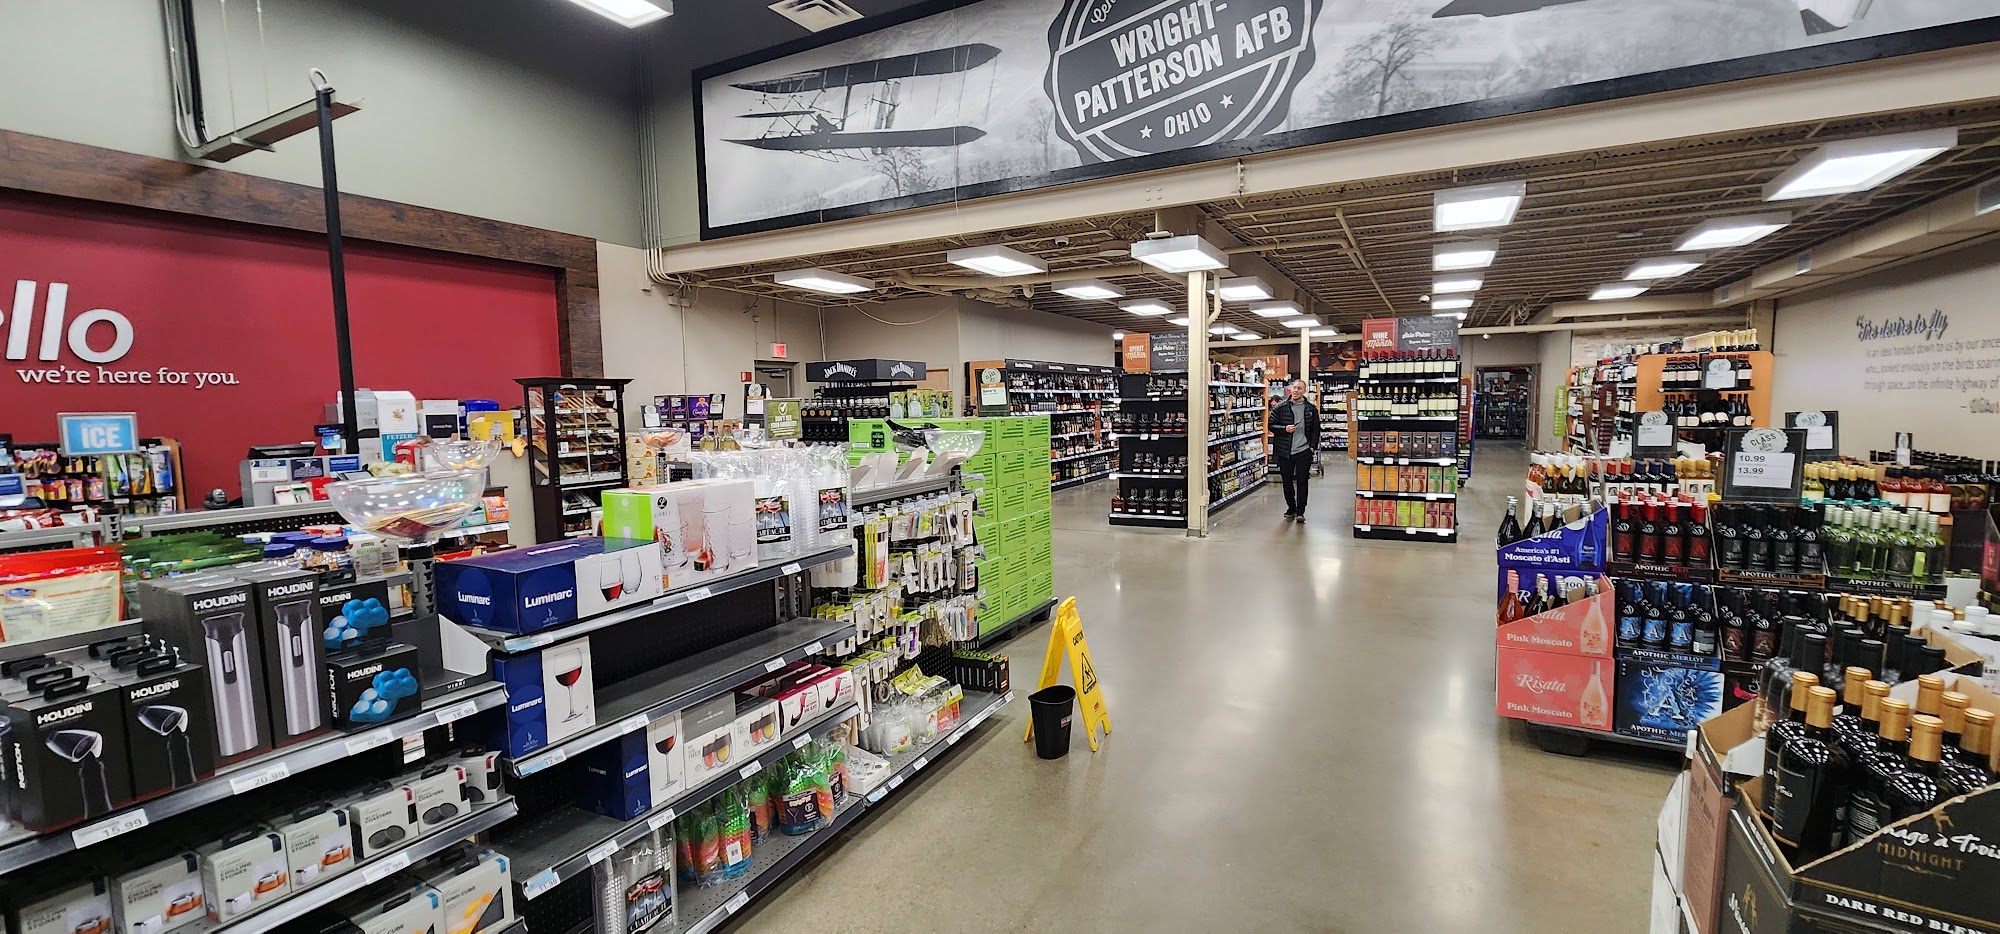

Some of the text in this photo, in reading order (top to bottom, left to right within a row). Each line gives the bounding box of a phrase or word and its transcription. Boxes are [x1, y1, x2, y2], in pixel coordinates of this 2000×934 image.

[1110, 0, 1228, 67] WRIGHT-
[1074, 6, 1293, 124] PATTERSON AFB
[1164, 102, 1212, 138] OHIO
[0, 279, 134, 364] llo
[1926, 308, 1948, 341] fly
[1372, 331, 1389, 340] WINE
[1365, 339, 1394, 349] Month
[97, 366, 151, 385] here
[157, 367, 189, 385] for
[189, 372, 240, 389] you.
[824, 364, 837, 379] JACK
[80, 426, 123, 449] ICE
[386, 433, 414, 441] FETZER
[1750, 432, 1777, 447] CLASS
[1739, 454, 1766, 463] 10.99
[1737, 467, 1764, 475] 13.99
[1504, 553, 1542, 562] Moscato
[1543, 554, 1571, 564] d'Asti
[1514, 546, 1560, 555] America's #1
[1634, 564, 1690, 574] APOTHIC RED
[1739, 569, 1778, 579] APOTHIC
[268, 581, 314, 598] HOUDINI
[1848, 578, 1892, 588] APOTHIC
[1893, 582, 1927, 591] WHITE
[193, 592, 248, 612] HOUDINI
[457, 591, 492, 606] Luminarc
[524, 586, 574, 609] Luminarc
[1072, 628, 1084, 646] CAUTION
[1506, 633, 1573, 648] Pink Moscato
[1632, 650, 1670, 660] APOTHIC
[1671, 654, 1705, 664] MERLOT
[347, 664, 383, 680] HOUDINI
[130, 679, 180, 700] HOUDINI
[1516, 673, 1566, 694] Risata
[328, 668, 339, 719] HOUDINI
[511, 695, 543, 713] Luminarc
[1506, 702, 1573, 719] Pink Moscato
[37, 702, 93, 725] HOUDINI
[452, 707, 474, 719] 18.99
[1630, 724, 1668, 736] APOTHIC
[367, 736, 389, 748] 9.99
[254, 769, 286, 787] 20.99
[625, 762, 648, 779] Luminarc
[102, 817, 143, 838] 15.99
[290, 835, 320, 849] CHILLING
[1933, 832, 1949, 848] à
[1876, 842, 1965, 871] MIDNIGHT
[220, 862, 252, 877] CHILLING
[384, 861, 404, 874] 9.99
[127, 883, 163, 901] CHILLING
[461, 886, 476, 897] CUBE
[539, 878, 558, 892] 11.99
[1825, 893, 1878, 915] DARK
[1882, 907, 1924, 926] RED
